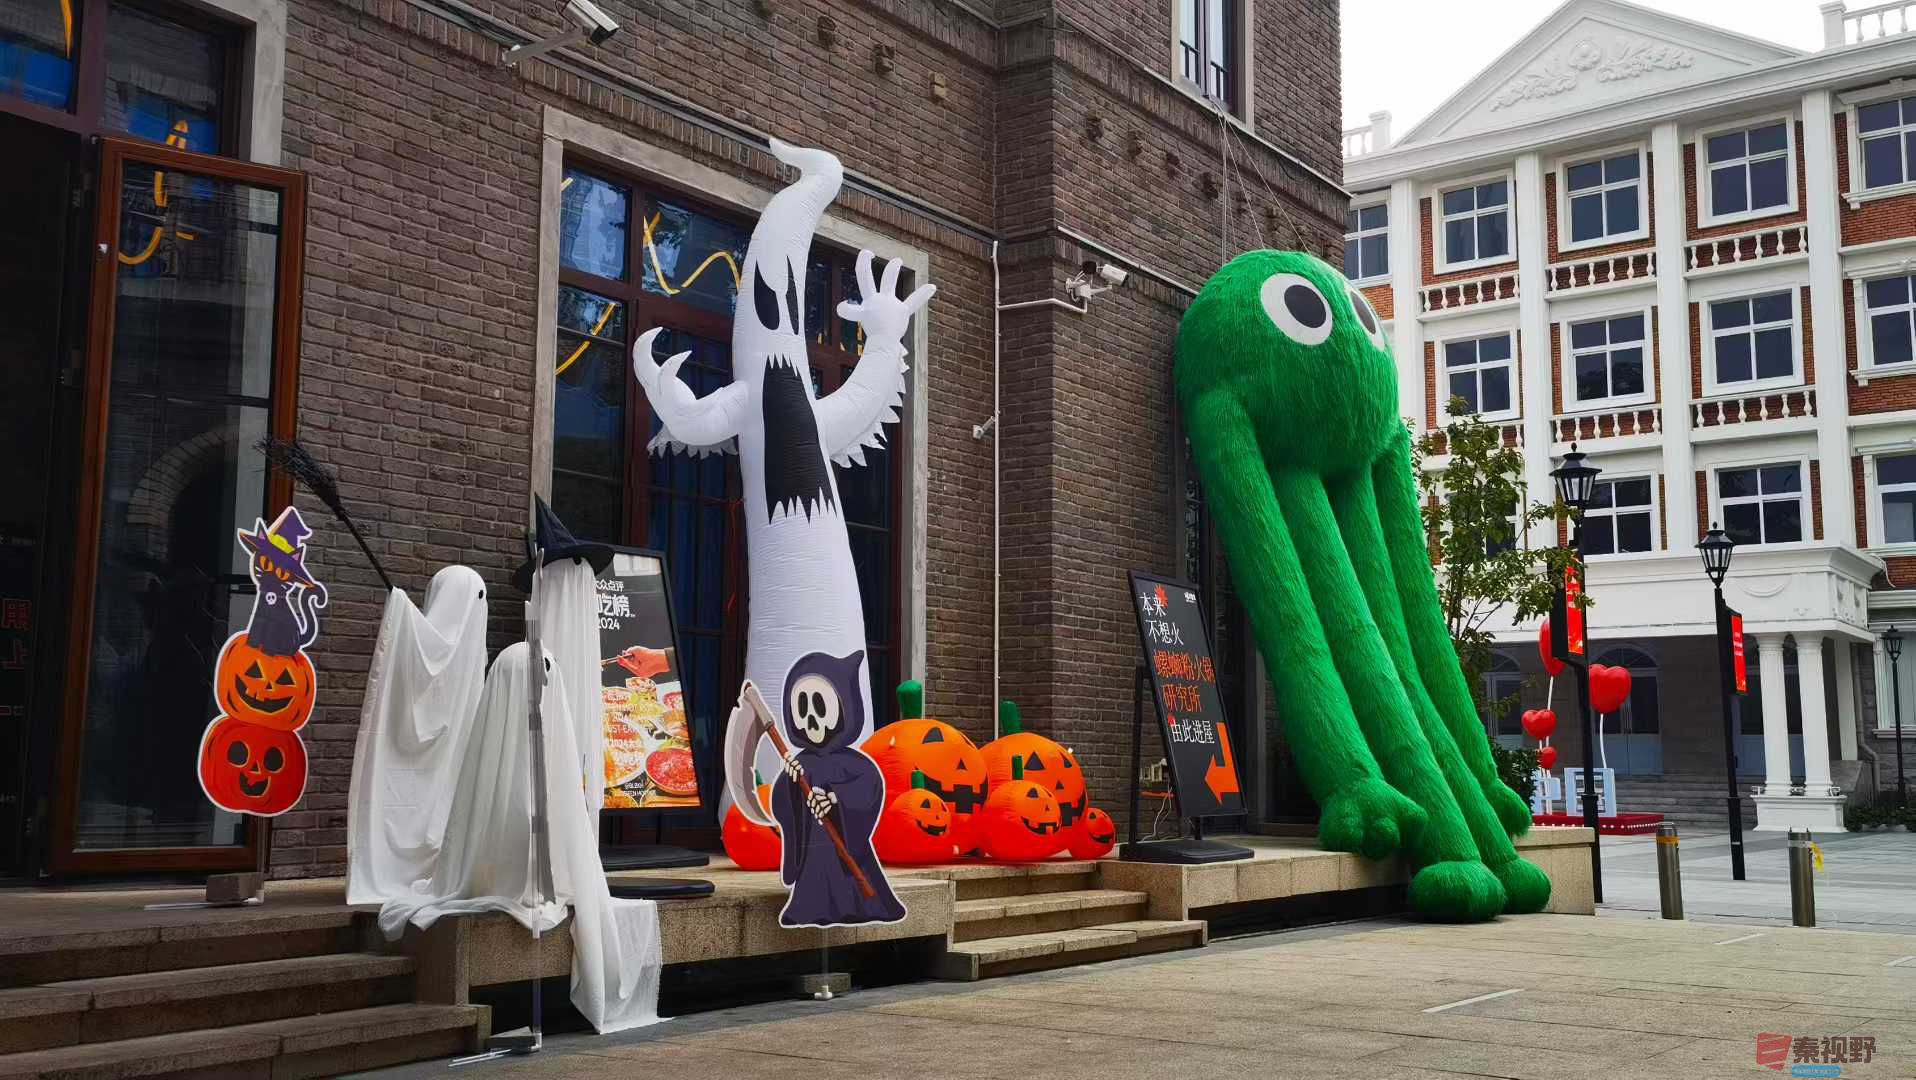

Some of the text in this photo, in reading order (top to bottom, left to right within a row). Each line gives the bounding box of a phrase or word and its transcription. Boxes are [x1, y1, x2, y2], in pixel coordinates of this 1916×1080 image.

[1139, 592, 1167, 617] 本来
[1145, 619, 1184, 646] 不想火
[1162, 684, 1202, 713] 研究所
[1171, 719, 1215, 744] 由此进屋
